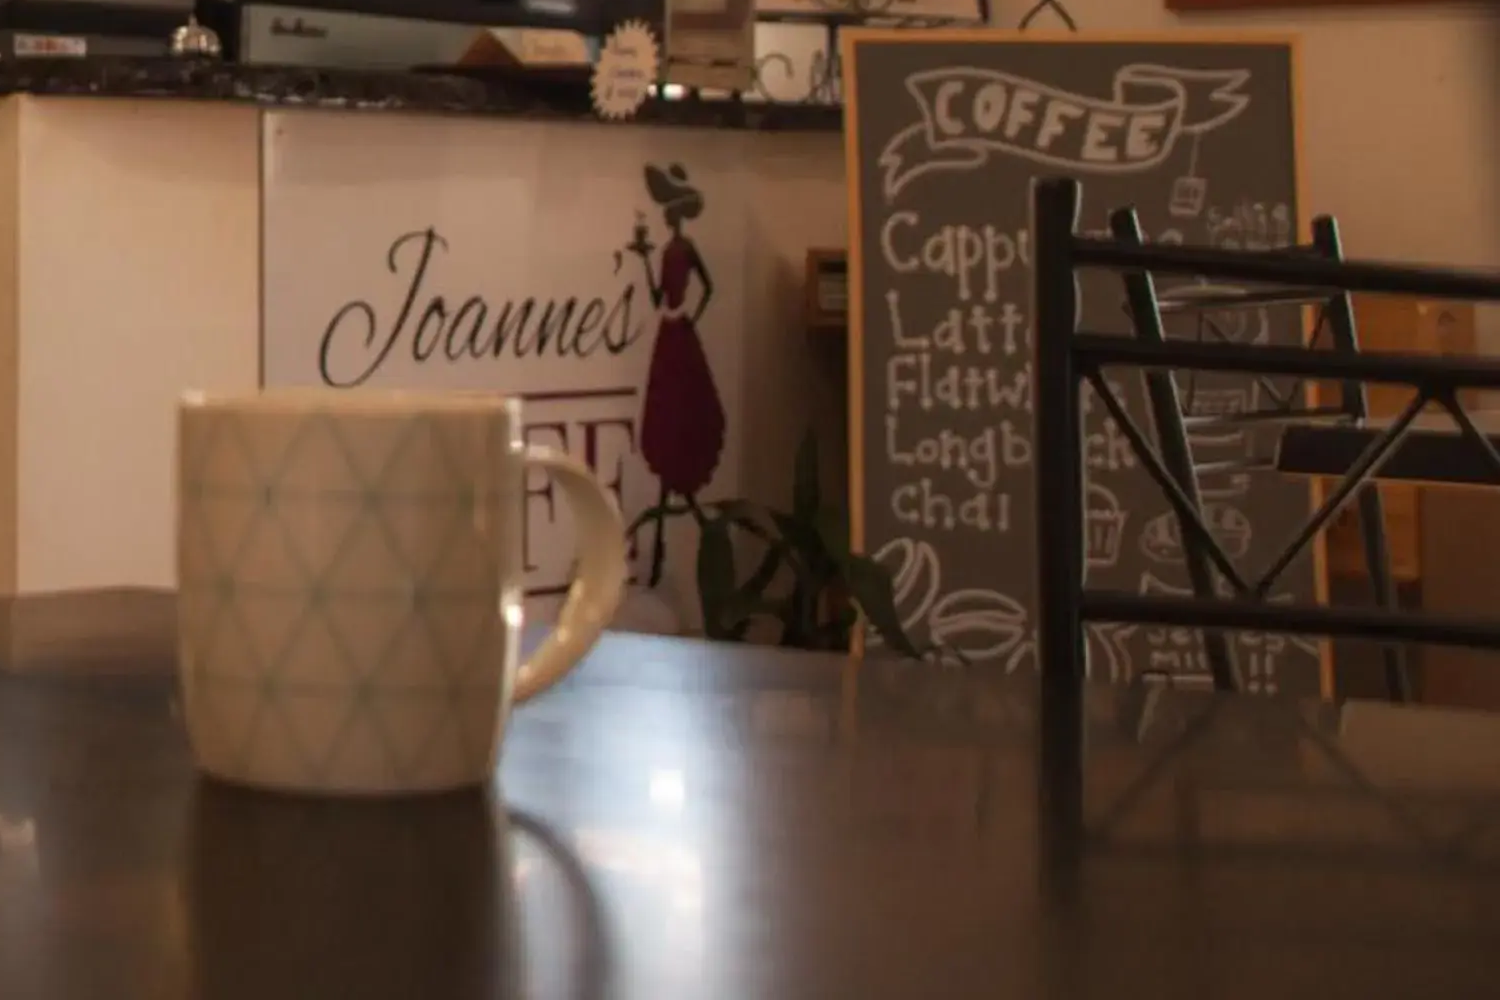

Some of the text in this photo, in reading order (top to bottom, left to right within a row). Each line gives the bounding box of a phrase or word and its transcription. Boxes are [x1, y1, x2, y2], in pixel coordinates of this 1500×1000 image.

[934, 80, 1167, 162] COFFEE
[318, 225, 645, 389] Joanne's
[886, 289, 1033, 354] Latt
